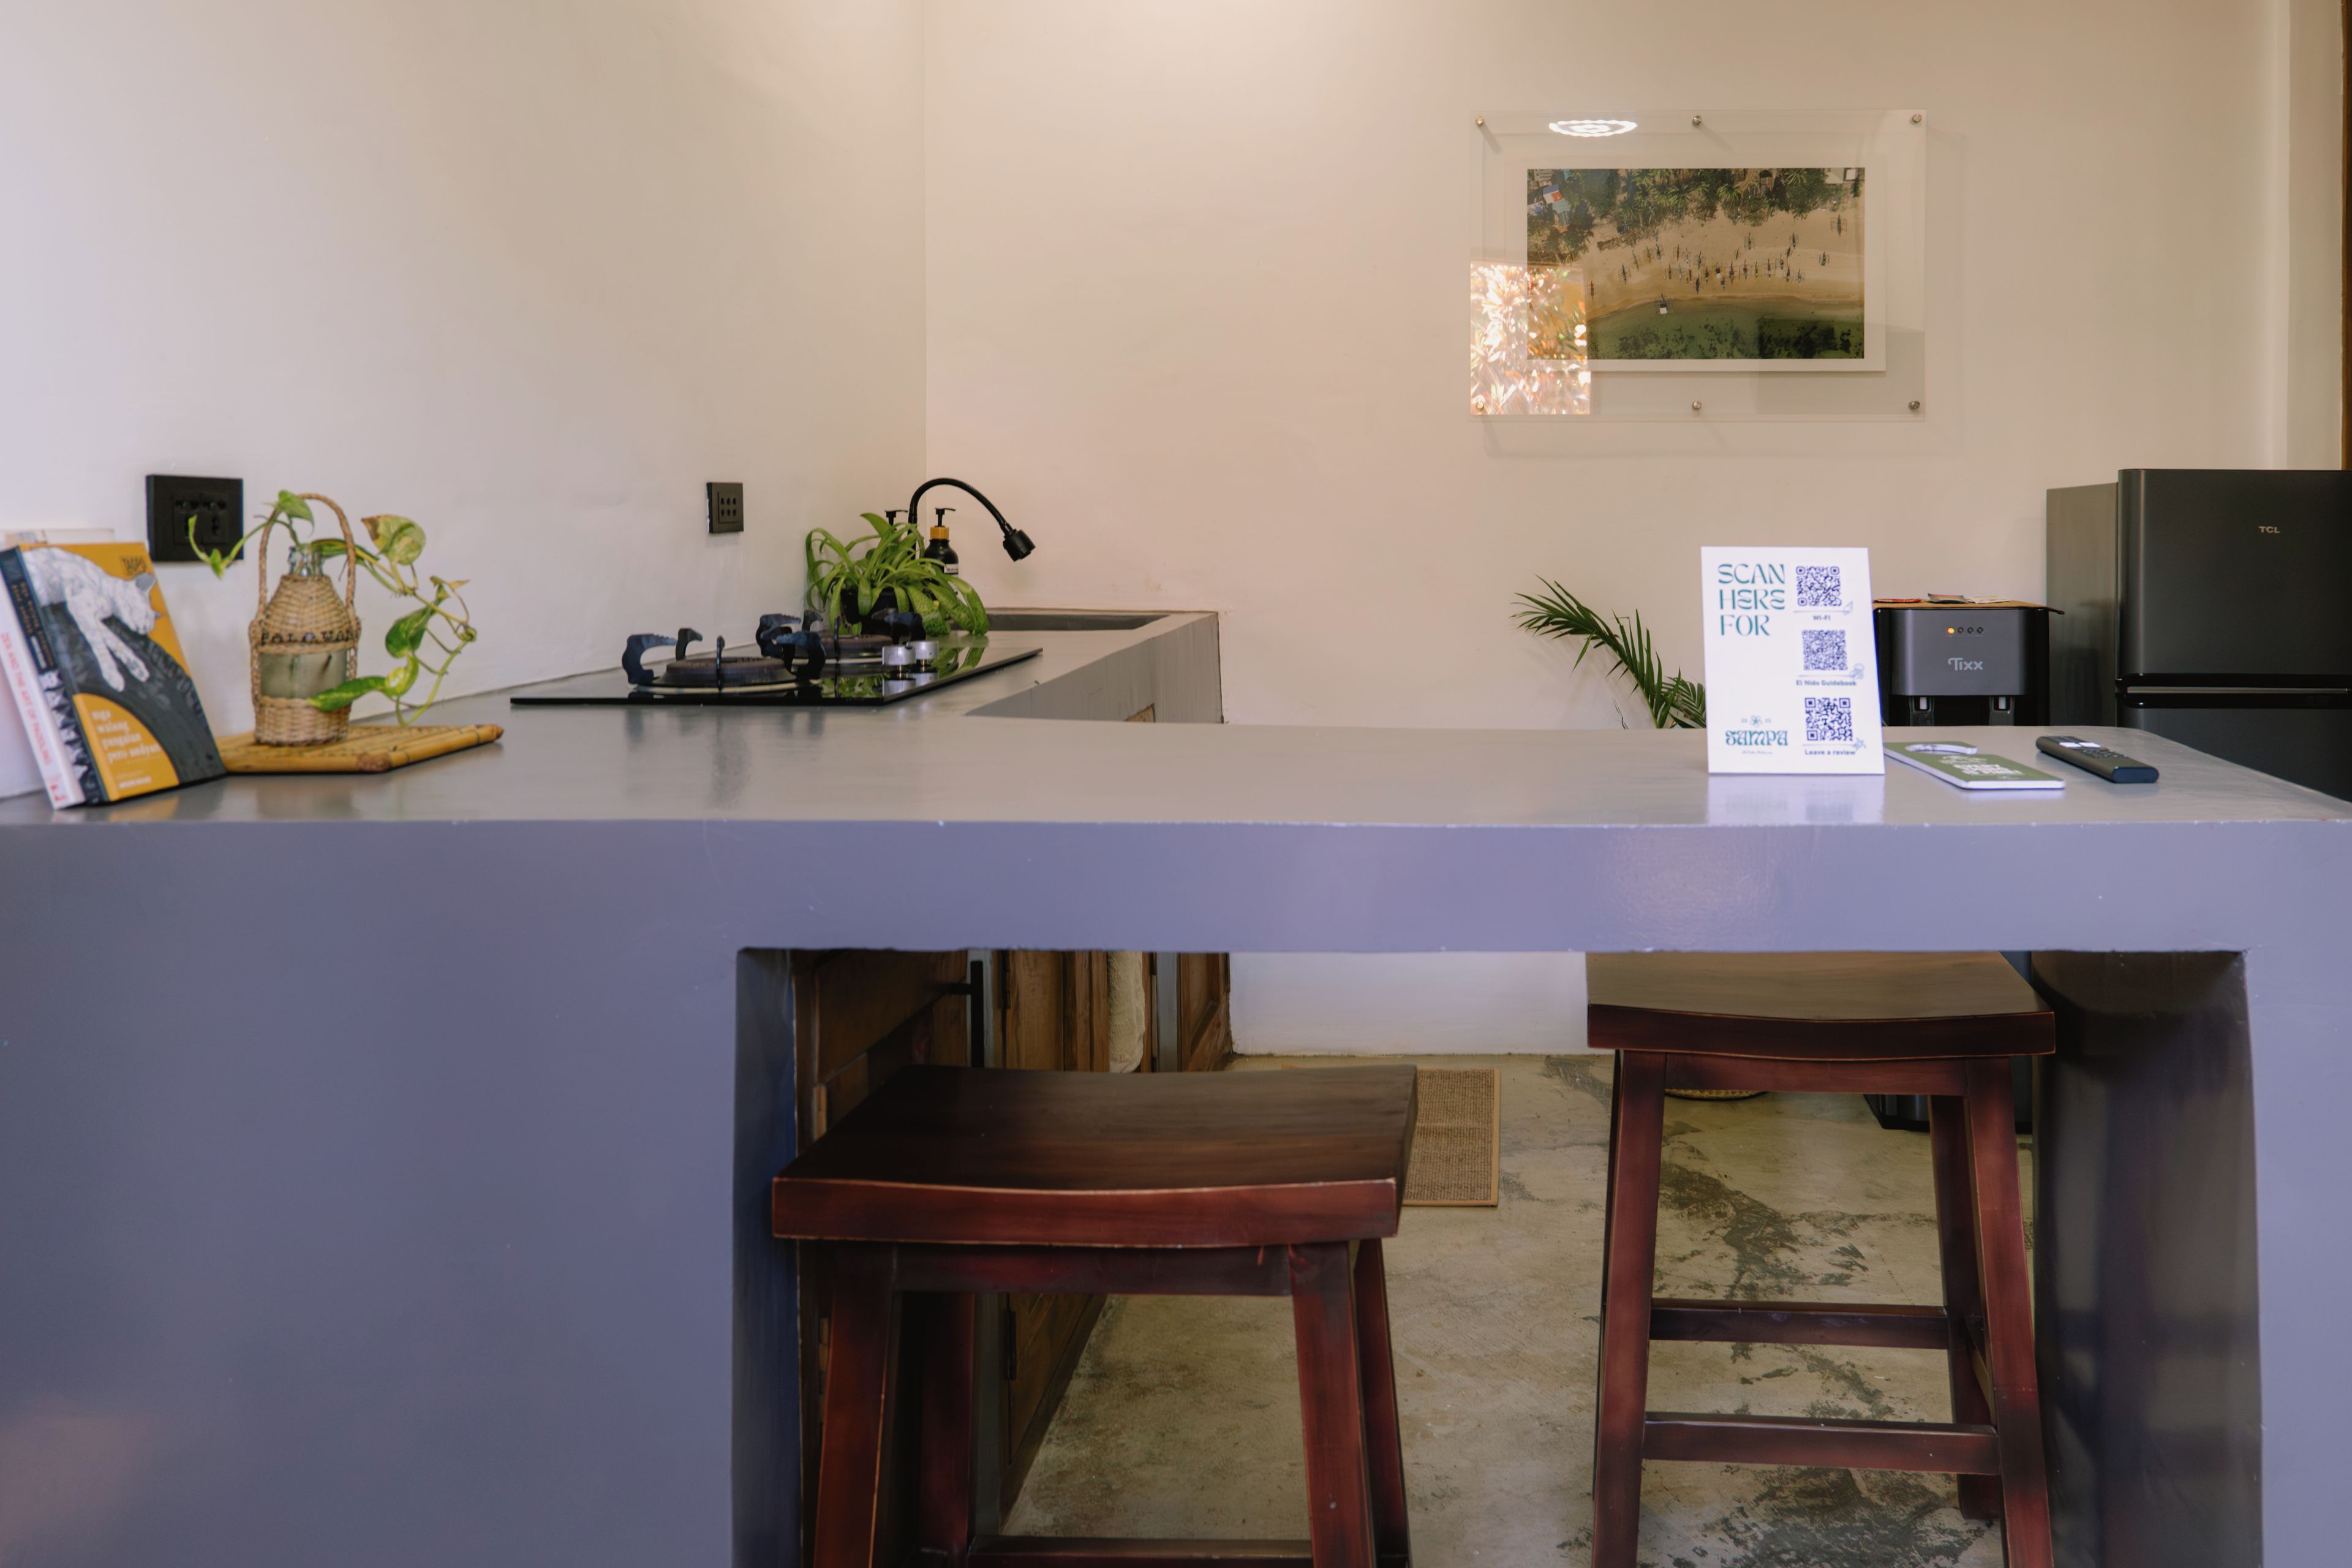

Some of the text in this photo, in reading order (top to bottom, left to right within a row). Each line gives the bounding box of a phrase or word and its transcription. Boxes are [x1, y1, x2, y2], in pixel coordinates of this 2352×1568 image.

[1717, 563, 1785, 584] SCAN
[1719, 589, 1785, 610] HERE
[1721, 614, 1771, 636] FOR
[1948, 657, 1983, 671] Tixx
